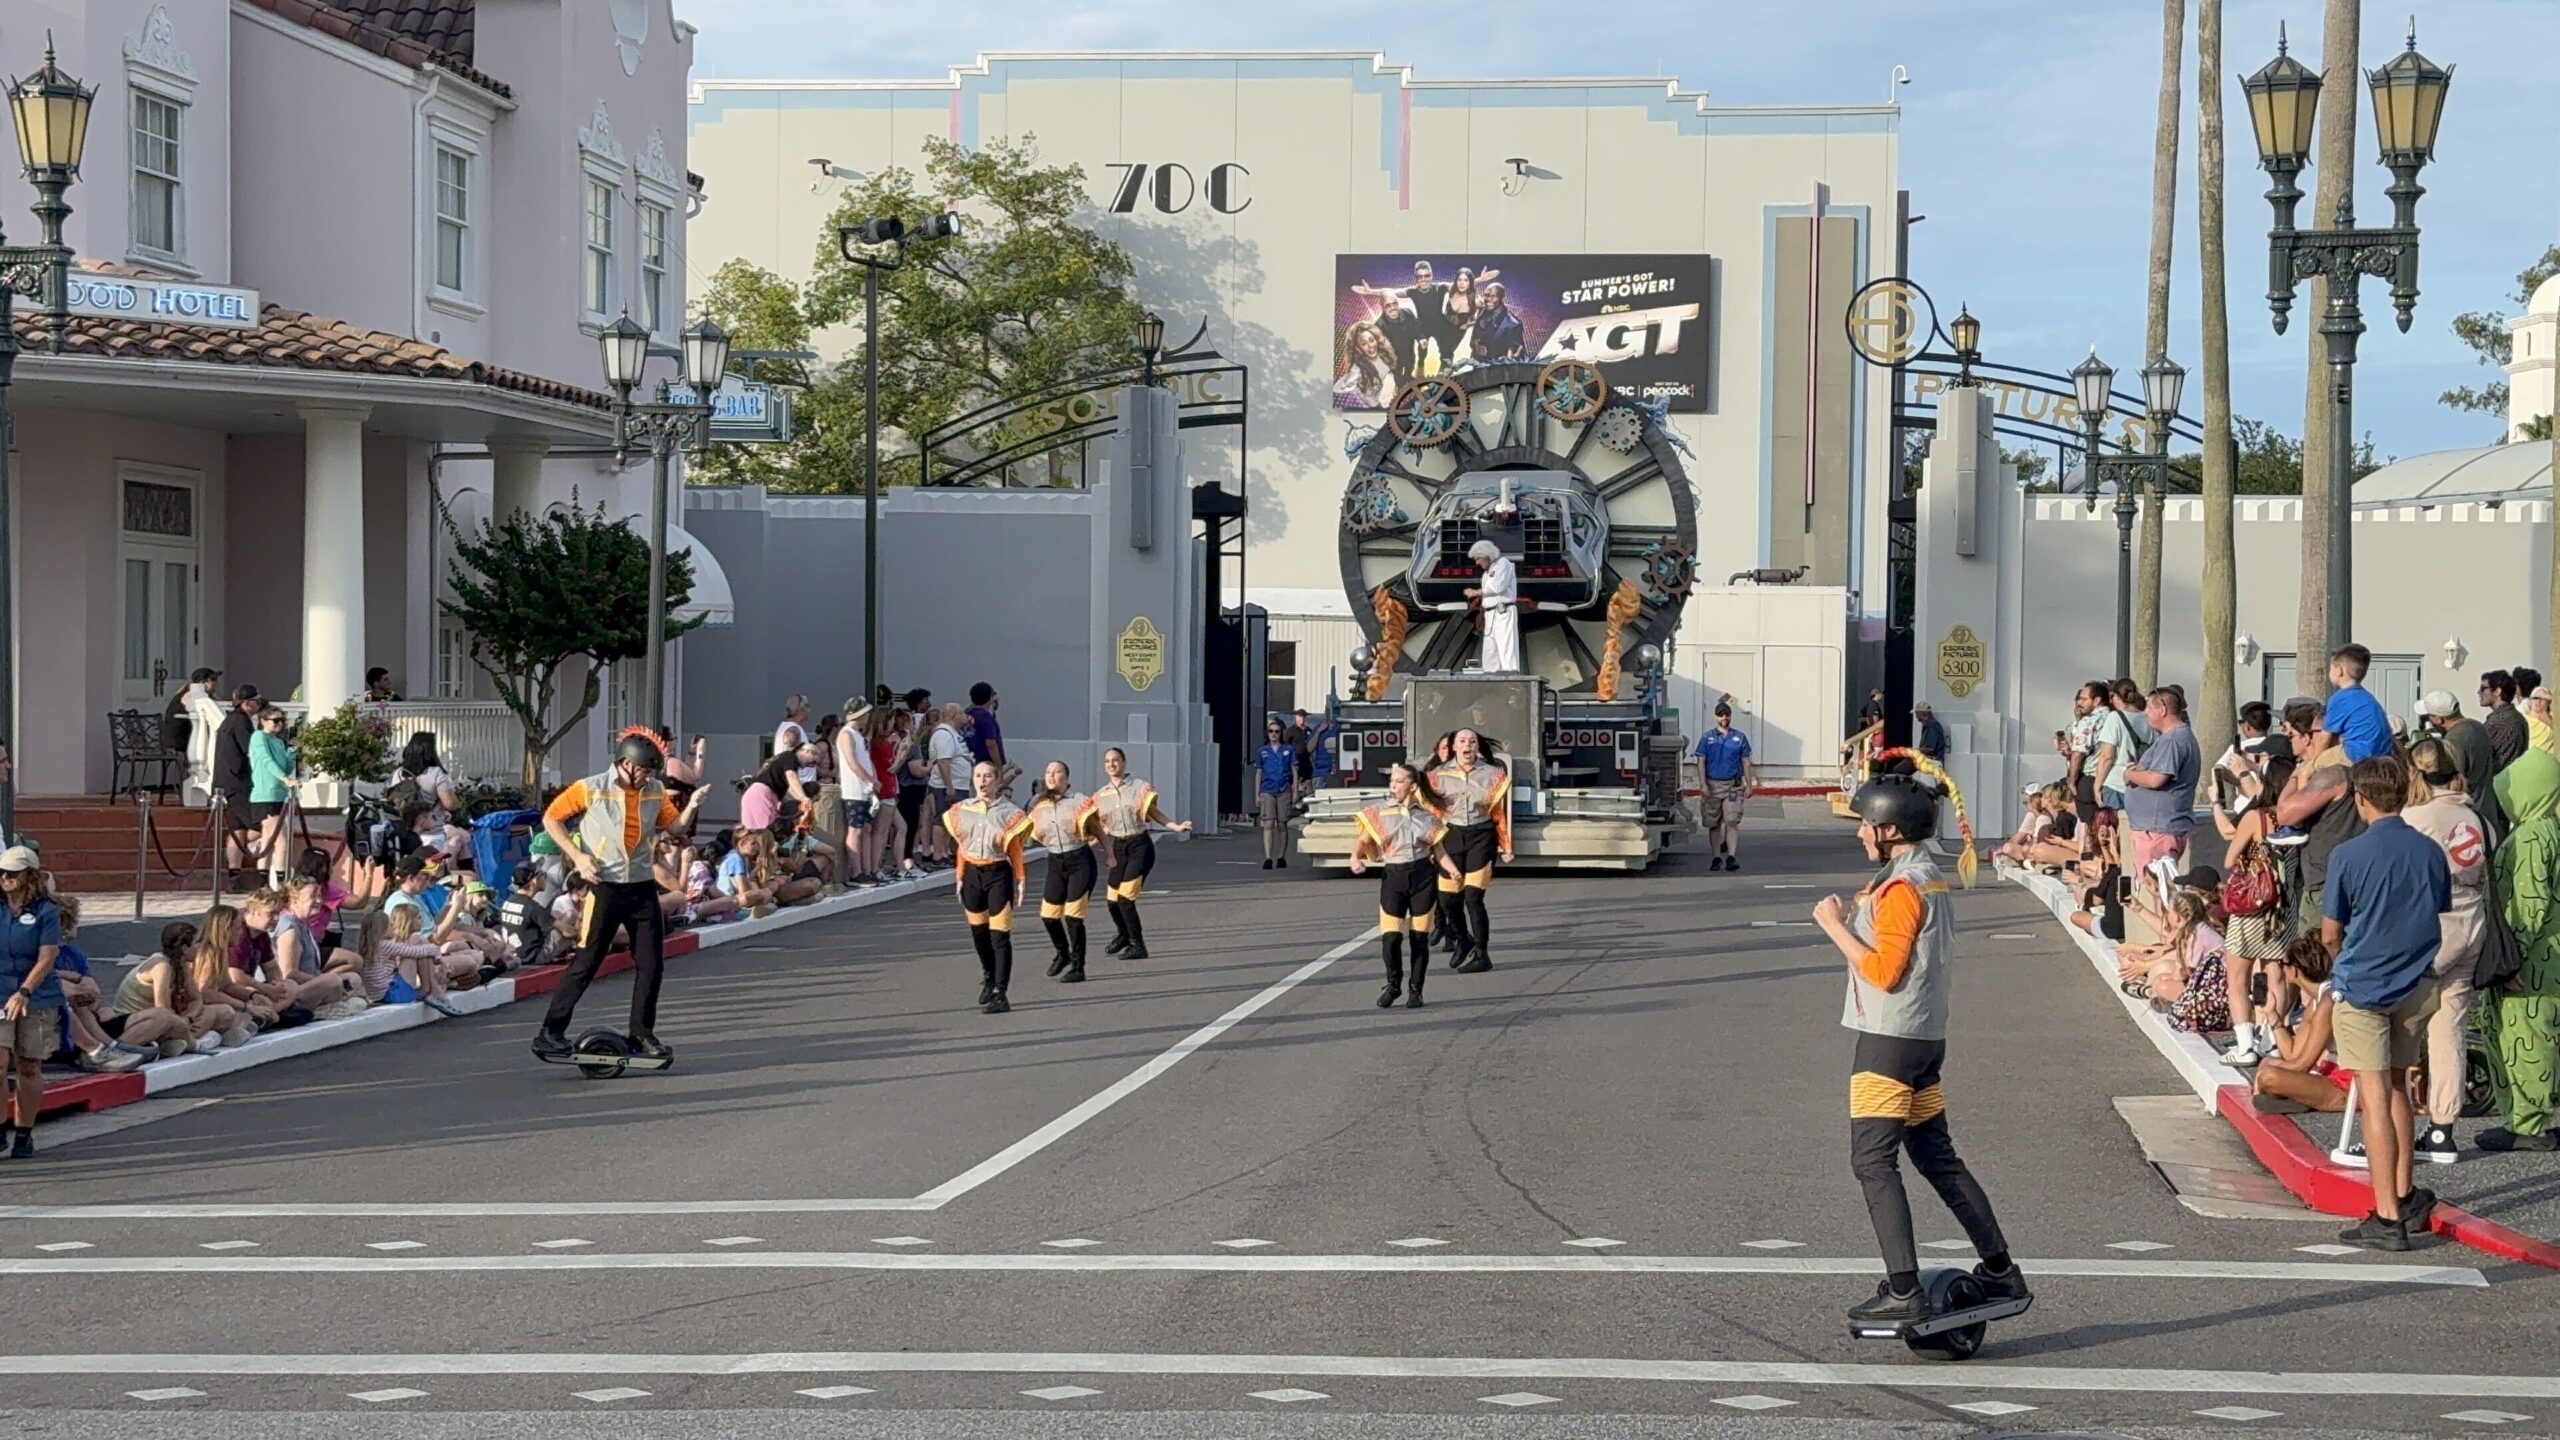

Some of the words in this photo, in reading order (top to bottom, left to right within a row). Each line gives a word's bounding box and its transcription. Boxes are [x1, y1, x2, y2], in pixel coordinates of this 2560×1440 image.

[1561, 287, 1603, 304] STAR
[1607, 278, 1676, 299] POWER!
[1581, 275, 1631, 290] SUMMER'S
[1632, 272, 1654, 283] GOT
[151, 288, 250, 321] HOTEL
[1536, 302, 1700, 363] AGT
[1643, 384, 1691, 398] peacock
[1942, 660, 1980, 675] 6300
